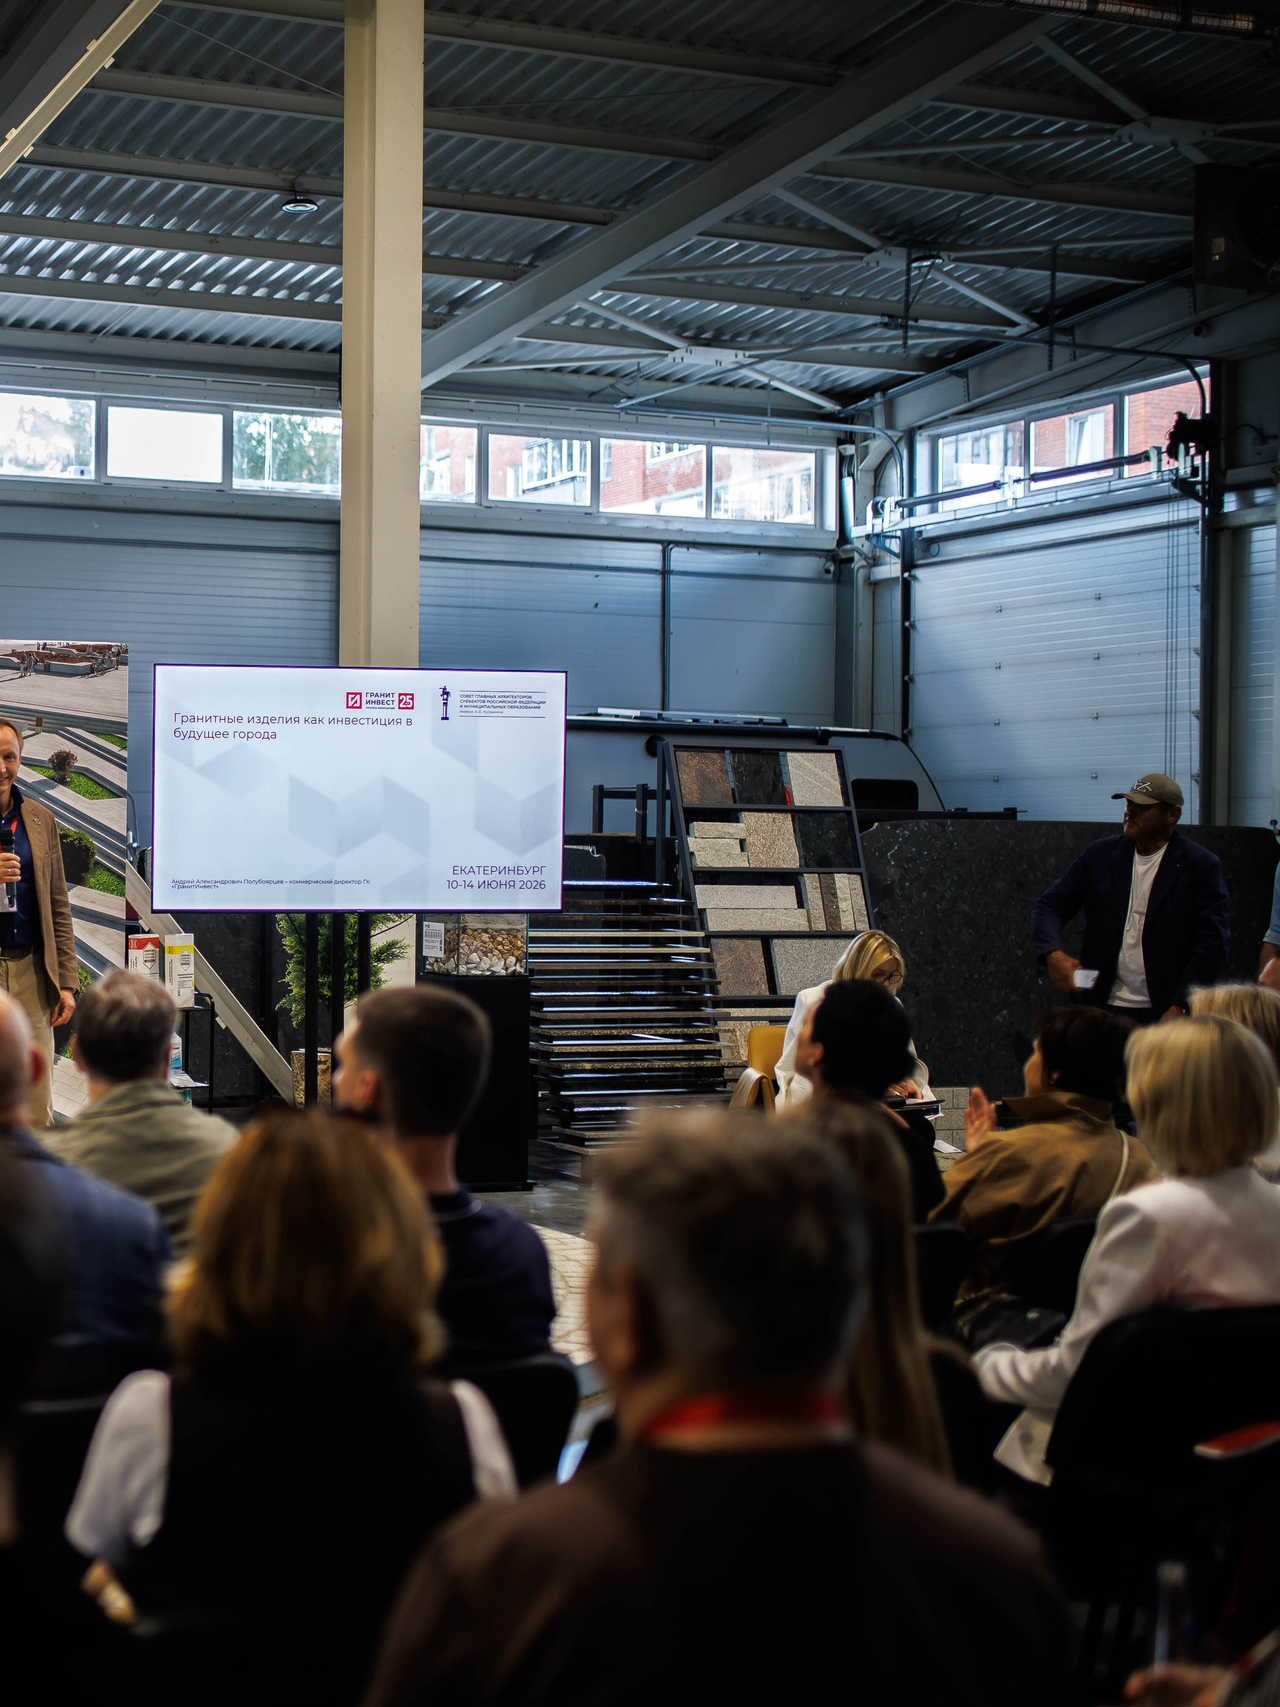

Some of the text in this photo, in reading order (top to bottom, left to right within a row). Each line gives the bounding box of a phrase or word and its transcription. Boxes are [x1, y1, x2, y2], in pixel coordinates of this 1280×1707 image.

[399, 695, 413, 708] 25
[173, 712, 413, 727] Гранитные изделия как инвестиция в
[173, 728, 277, 741] будущее города
[452, 865, 547, 876] ЕКАТЕРИНБУРГ
[446, 879, 547, 890] 10-14 ИЮНЯ 2026
